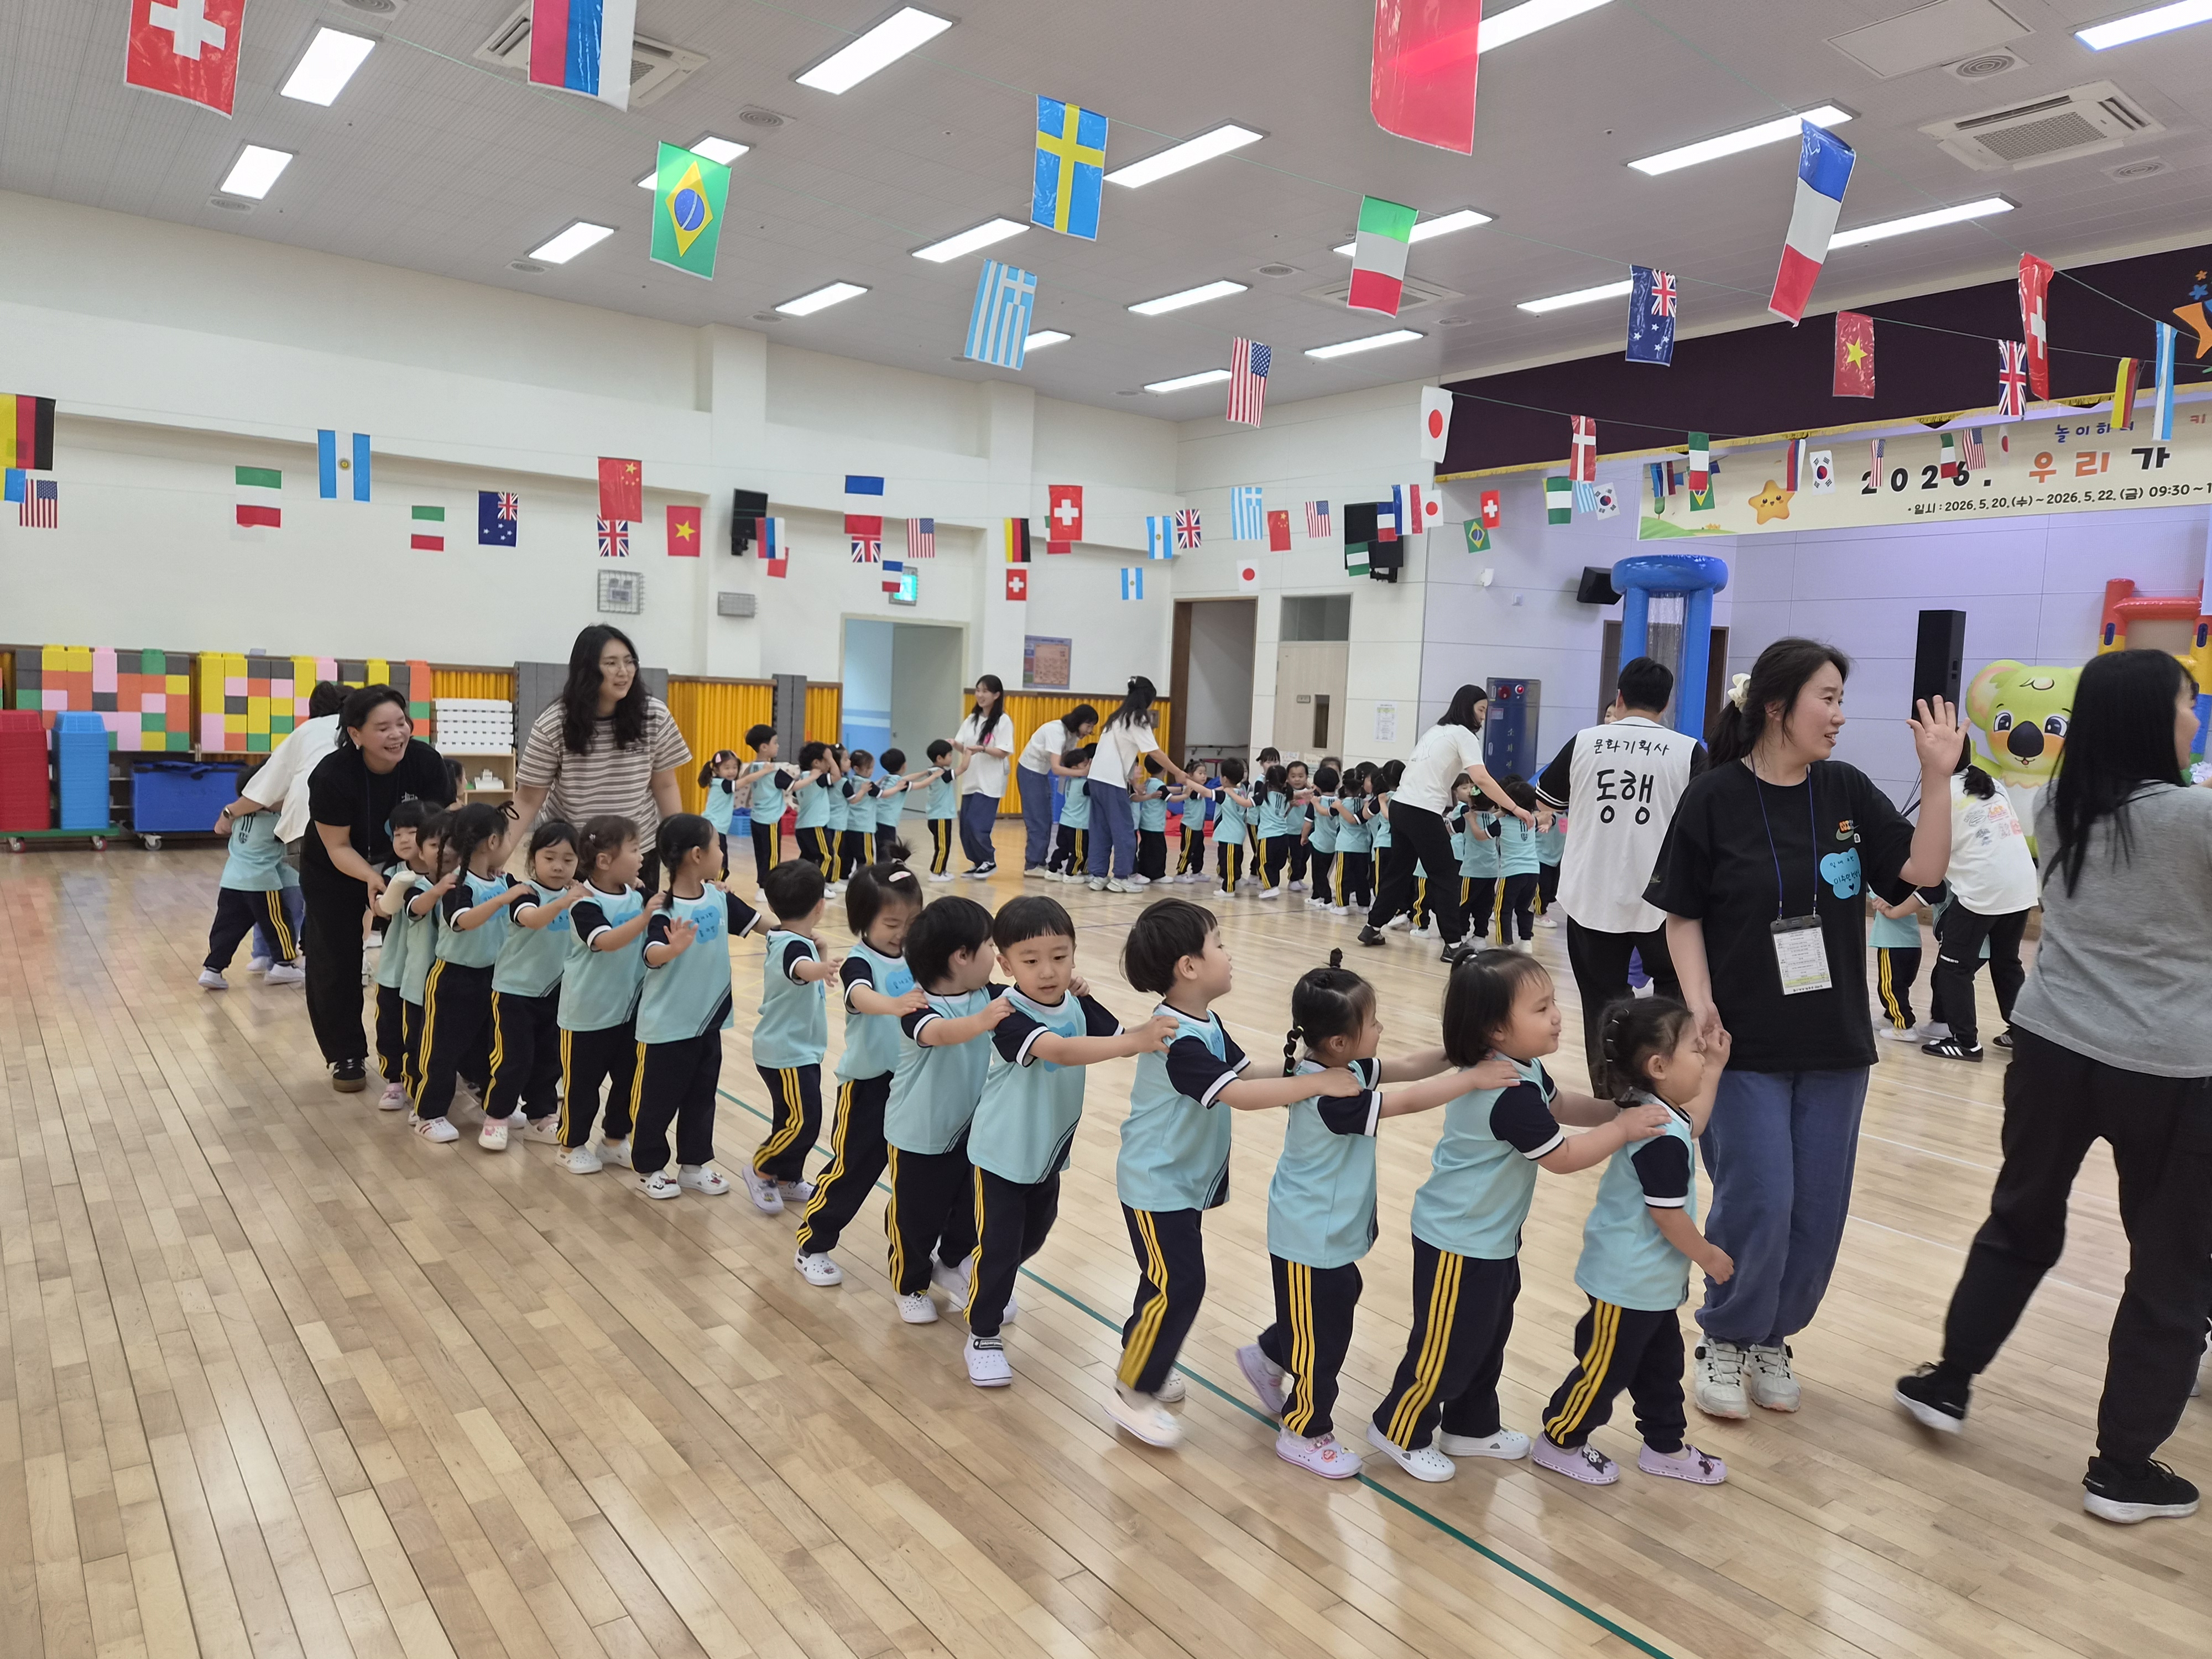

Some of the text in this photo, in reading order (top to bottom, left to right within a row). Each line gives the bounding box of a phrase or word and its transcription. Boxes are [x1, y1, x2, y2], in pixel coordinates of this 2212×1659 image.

[2029, 451, 2110, 483] 우리
[2131, 447, 2171, 470] 가
[2149, 484, 2190, 497] 09:30
[1594, 739, 1670, 756] 문화기획사
[1597, 769, 1654, 825] 동행
